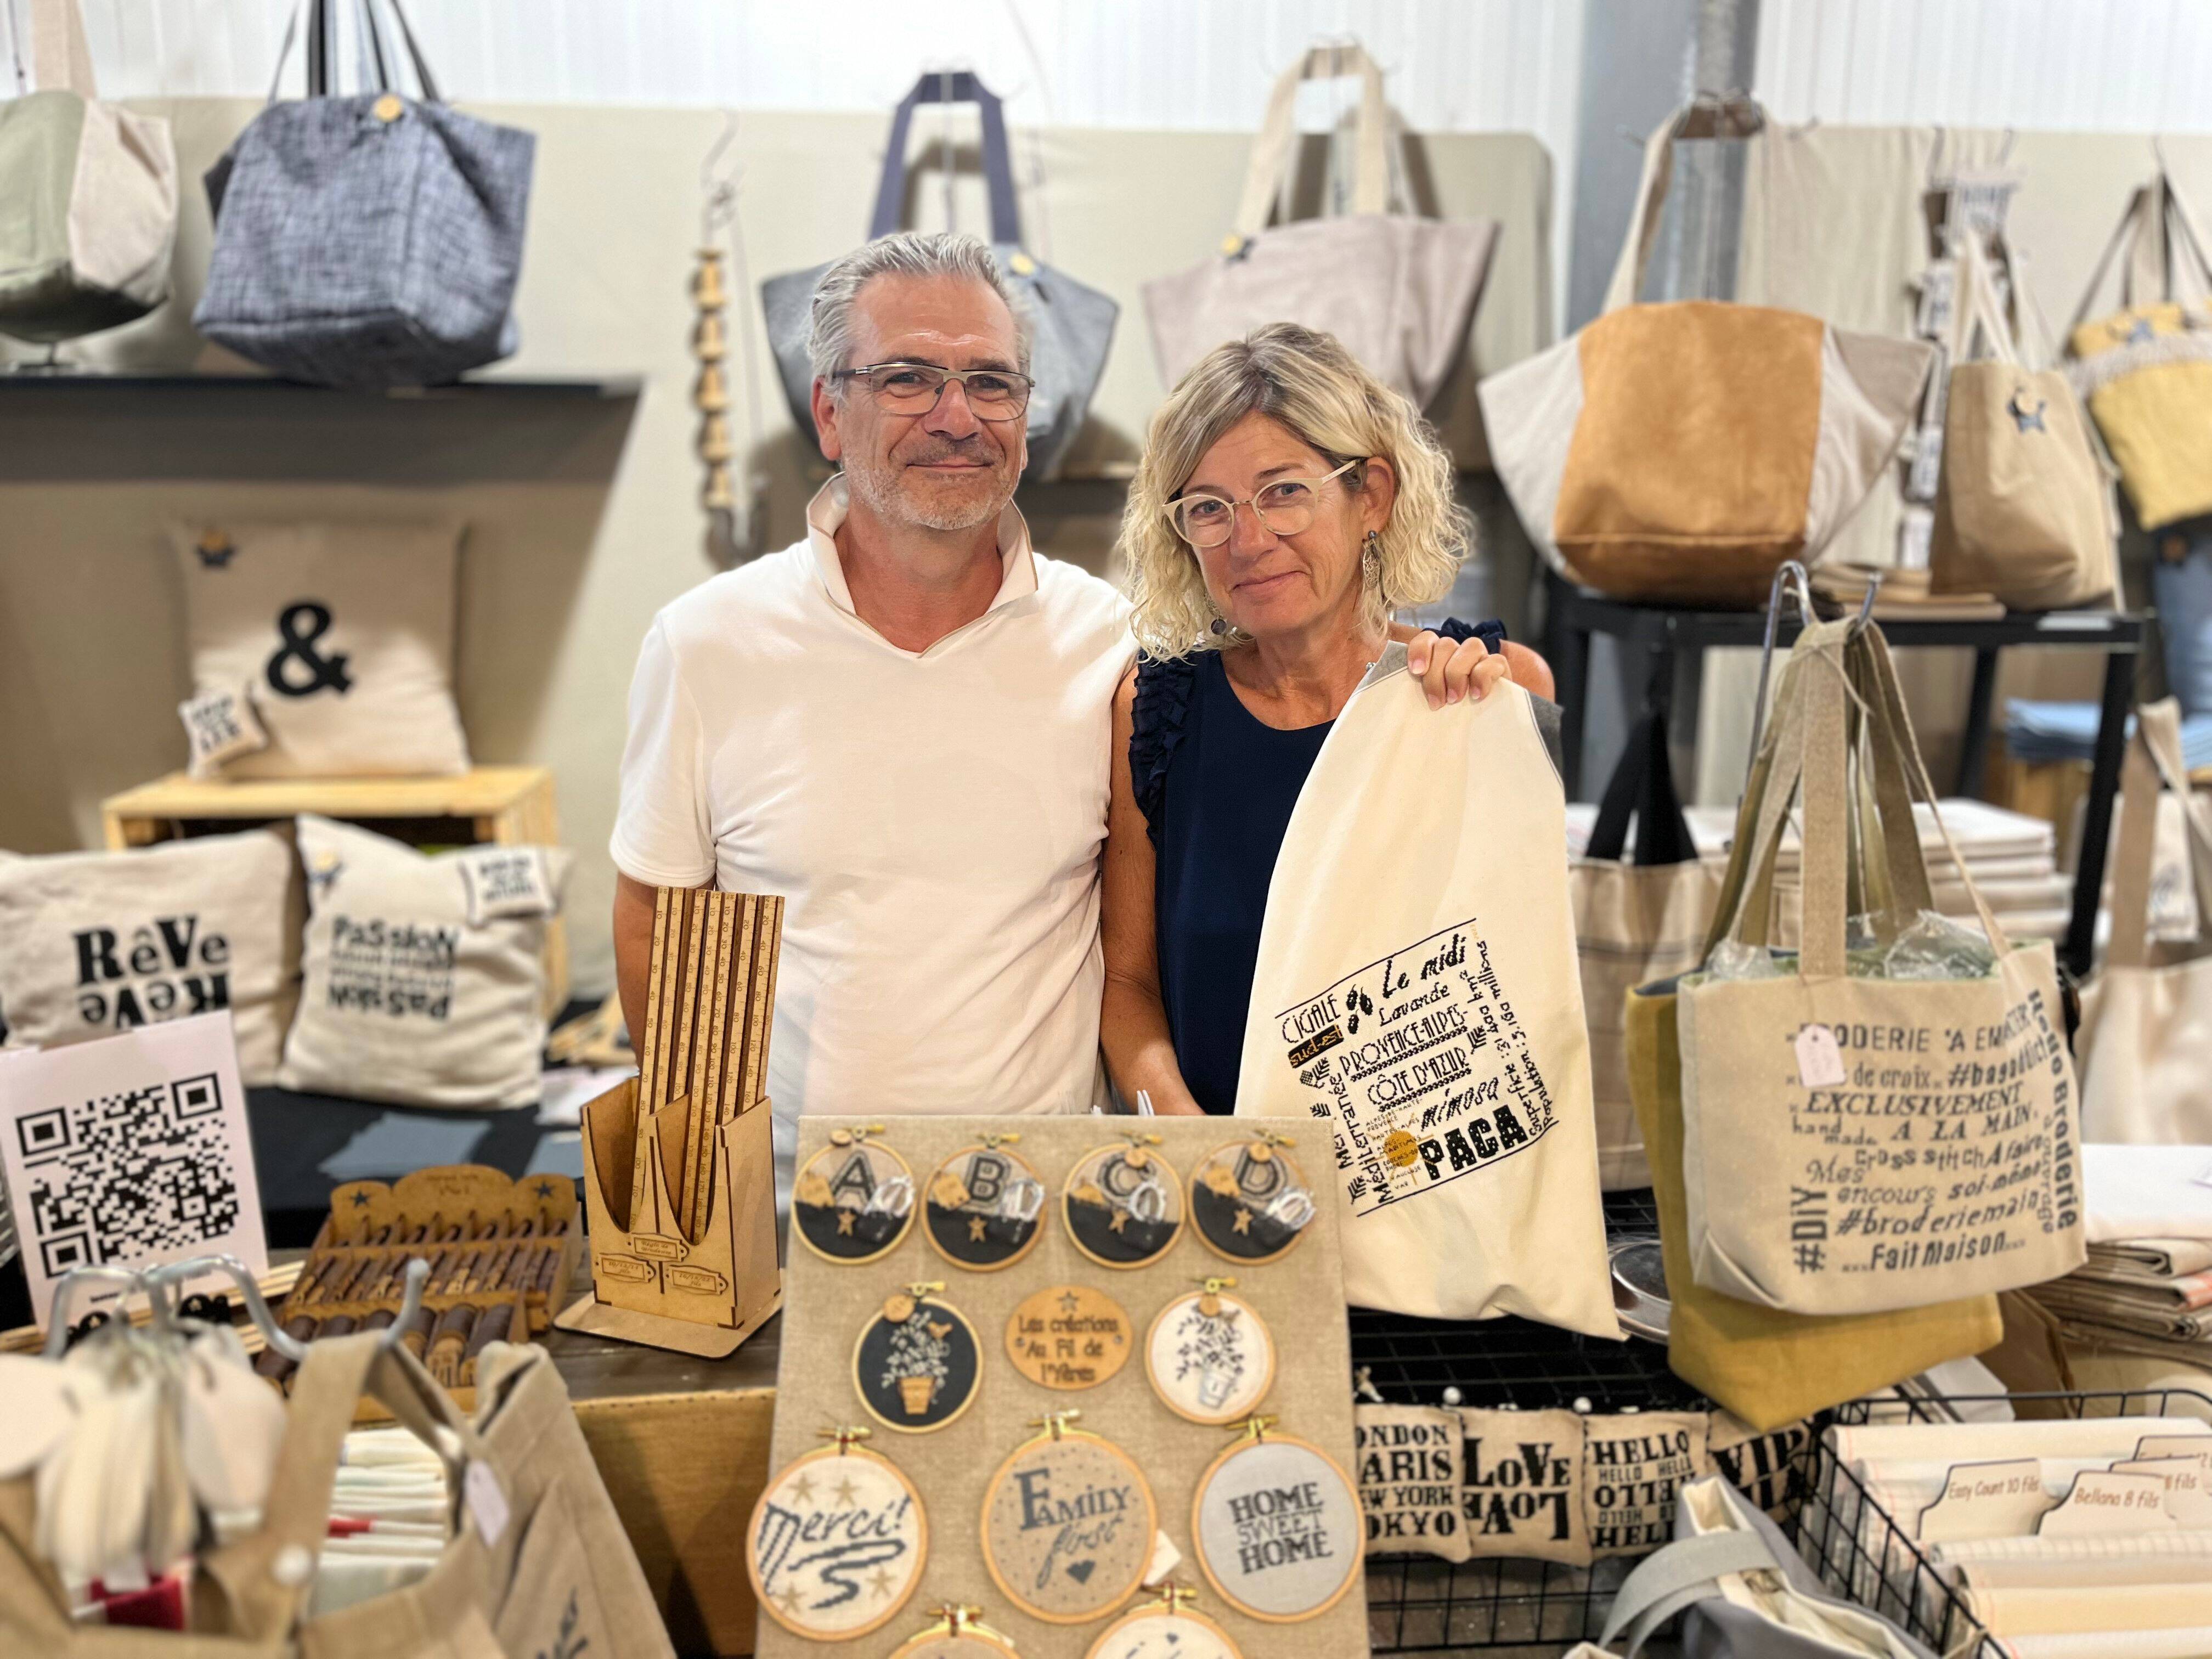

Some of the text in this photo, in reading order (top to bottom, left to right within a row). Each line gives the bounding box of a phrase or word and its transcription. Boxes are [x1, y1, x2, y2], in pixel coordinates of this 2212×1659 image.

[267, 603, 354, 697] &
[1383, 933, 1467, 999] Le midi
[1476, 940, 1500, 1000] millions
[1282, 993, 1341, 1043] CIGALE
[1379, 981, 1450, 1026] Lavande
[1800, 1024, 1931, 1052] ODERIE
[1367, 1047, 1469, 1105] CÔTE D'AZUR
[1521, 1053, 1554, 1128] Population
[1804, 1081, 2023, 1115] EXCLUSIVEMENT
[1418, 1104, 1527, 1181] PACA
[1792, 1114, 1842, 1134] hand
[1930, 1120, 1966, 1141] LA
[830, 1152, 876, 1204] A
[2055, 1081, 2078, 1230] Broderie
[968, 1154, 1008, 1205] B
[1361, 1450, 1453, 1483] ARIS
[1593, 1430, 1690, 1465] HELLO
[1599, 1466, 1642, 1482] HELLO
[1227, 1482, 1324, 1524] HOME
[1359, 1486, 1454, 1510] EW YORK
[1238, 1531, 1334, 1575] HOME
